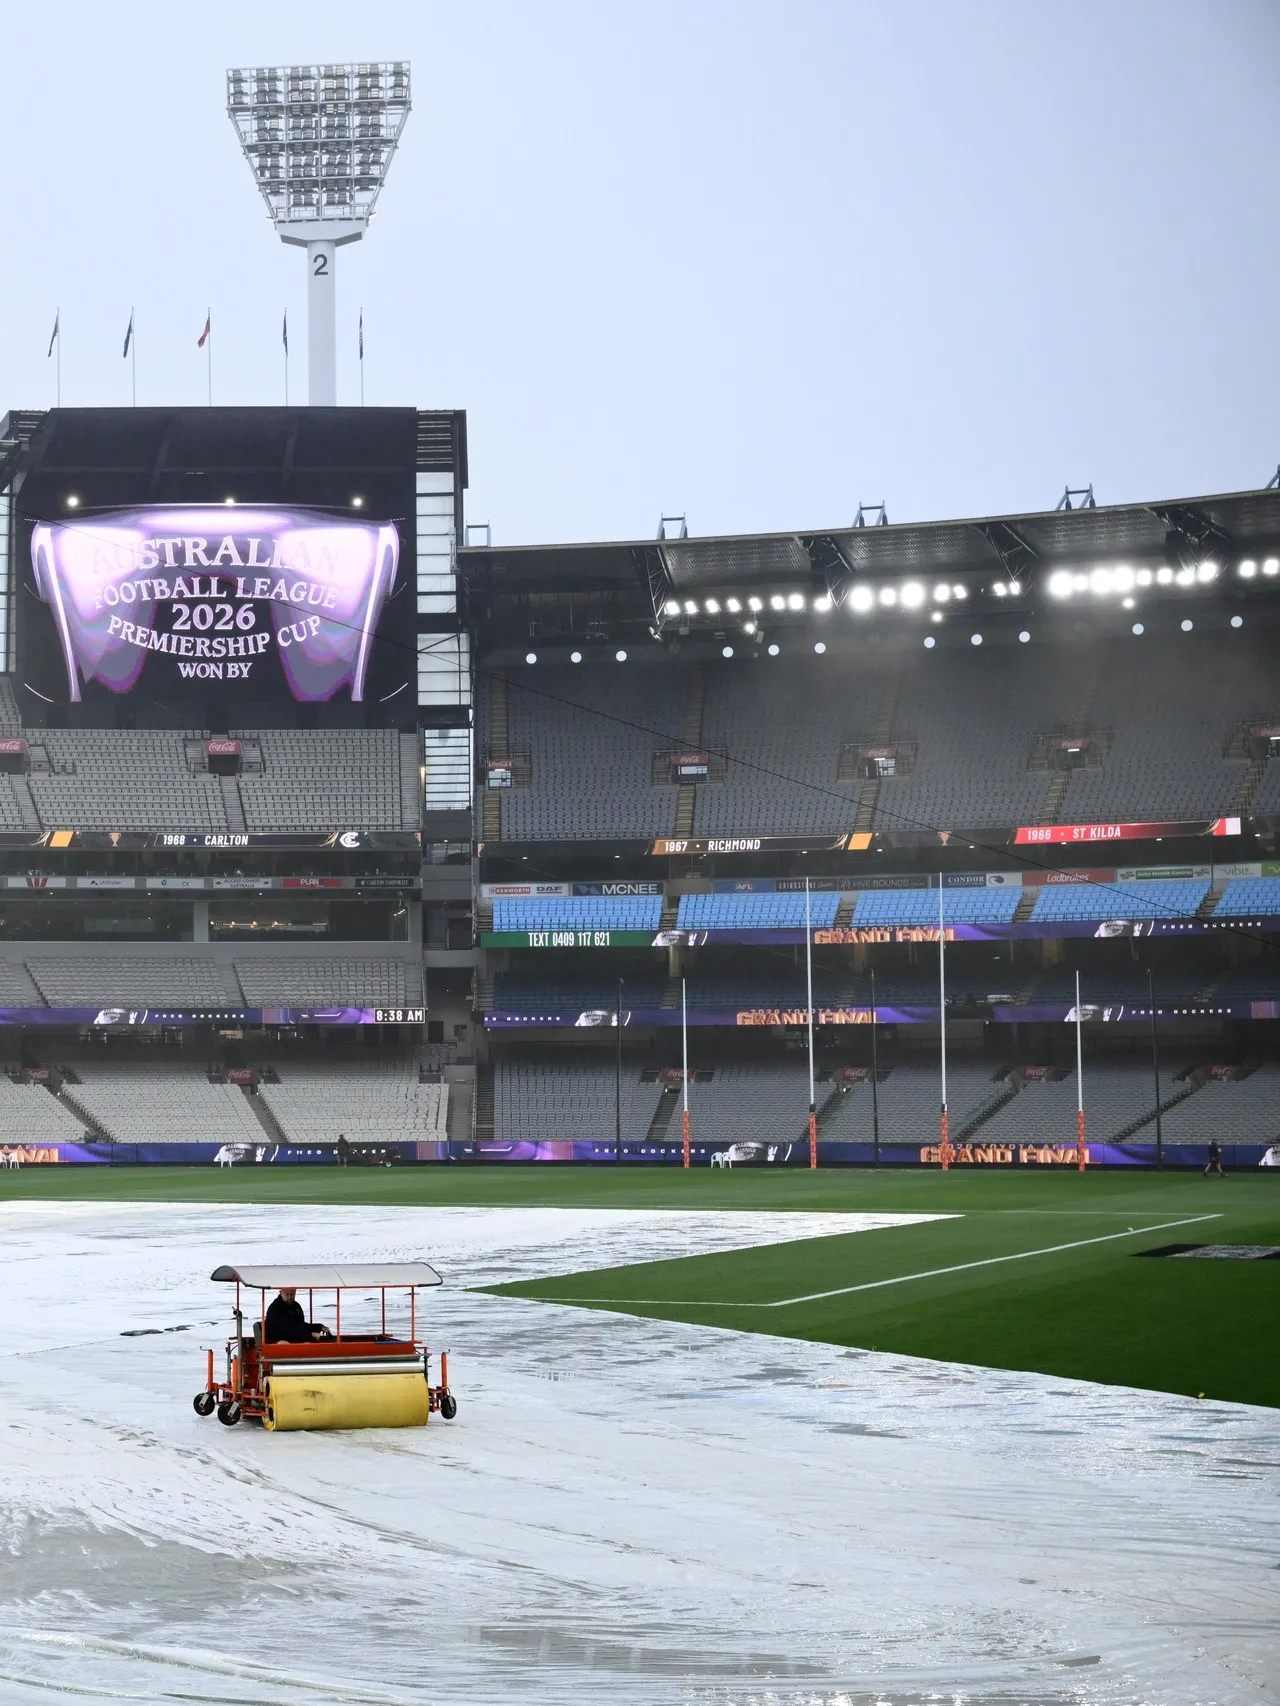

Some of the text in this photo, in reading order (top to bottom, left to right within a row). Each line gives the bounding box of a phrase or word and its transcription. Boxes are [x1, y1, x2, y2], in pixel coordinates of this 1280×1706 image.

[313, 253, 329, 276] 2
[91, 535, 339, 574] AUSTRALIAN
[94, 575, 337, 610] FOOTBALL LEAGUE
[171, 603, 256, 631] 2026
[106, 614, 322, 658] PREMIERSHIP CUP
[177, 661, 253, 680] WON BY
[209, 742, 236, 751] Coca-Cola
[163, 834, 249, 845] 1968 CARLTON
[1027, 826, 1122, 840] 1966 ST KILDA
[664, 840, 761, 851] 1967 RICHMOND
[873, 879, 909, 887] BOUNDS
[1046, 873, 1089, 883] Ladbrokes
[602, 884, 658, 894] MCNEE
[736, 882, 753, 890] AFL
[528, 932, 610, 947] TEXT 0409 117 621
[814, 928, 960, 944] GRAND FINAL
[376, 1010, 423, 1022] 8:38 AM
[737, 1012, 810, 1025] GRAND
[920, 1147, 1012, 1164] GRAND
